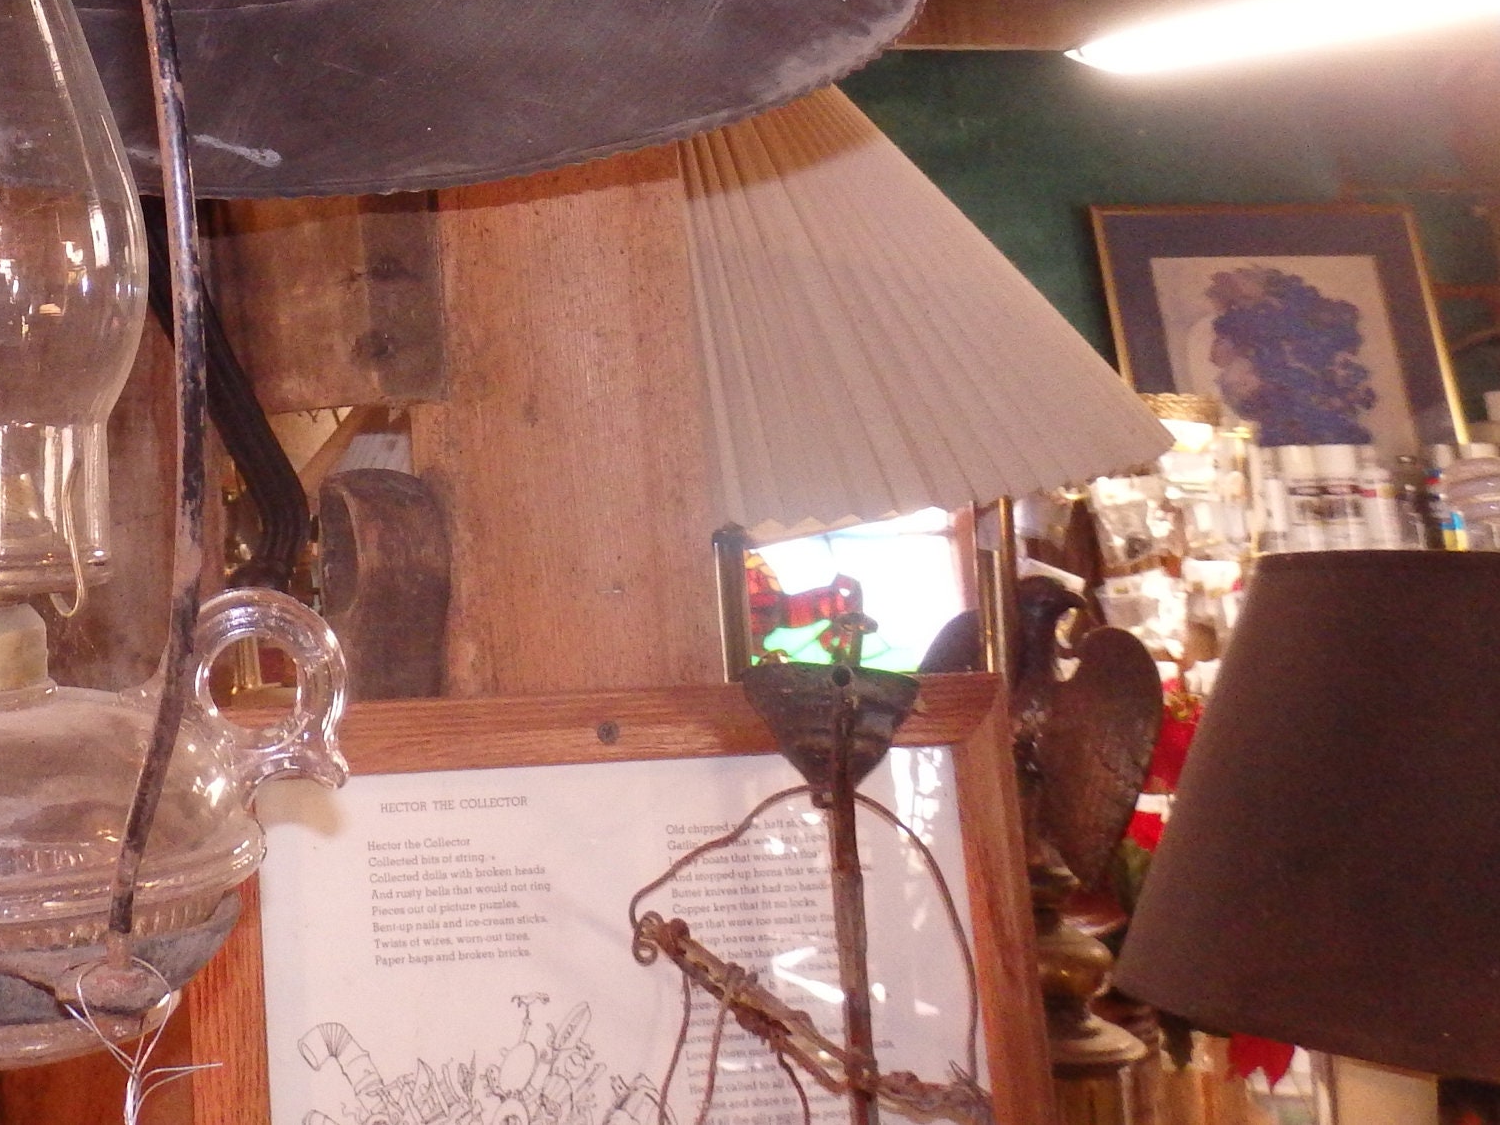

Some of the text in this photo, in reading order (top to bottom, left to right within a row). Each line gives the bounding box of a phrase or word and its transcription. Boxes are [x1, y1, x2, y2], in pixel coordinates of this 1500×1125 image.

[380, 795, 528, 813] HECTOR THE COLLECTOR
[665, 824, 685, 835] Old
[687, 821, 729, 836] chipped
[367, 836, 470, 851] Hector the Collector
[368, 855, 418, 867] Collected
[420, 855, 441, 865] bits
[442, 853, 453, 863] of
[731, 852, 751, 864] that
[369, 864, 546, 883] Collected dolls with broken heads
[784, 865, 804, 876] that
[371, 888, 393, 900] And
[395, 887, 422, 900] rusty
[425, 884, 450, 897] bells
[452, 884, 472, 895] that
[475, 882, 507, 893] would
[510, 882, 527, 892] not
[704, 886, 738, 897] knives
[740, 884, 759, 895] that
[762, 882, 781, 893] had
[371, 905, 405, 916] Pieces
[407, 904, 424, 914] out
[426, 903, 437, 913] of
[439, 902, 476, 915] picture
[672, 903, 710, 917] Copper
[713, 901, 738, 914] keys
[740, 899, 758, 911] that
[415, 919, 440, 930] nails
[442, 917, 462, 928] and
[373, 937, 408, 949] Twists
[409, 936, 420, 947] of
[375, 954, 405, 967] Paper
[407, 952, 434, 965] bags
[435, 950, 456, 961] and
[458, 949, 496, 961] broken
